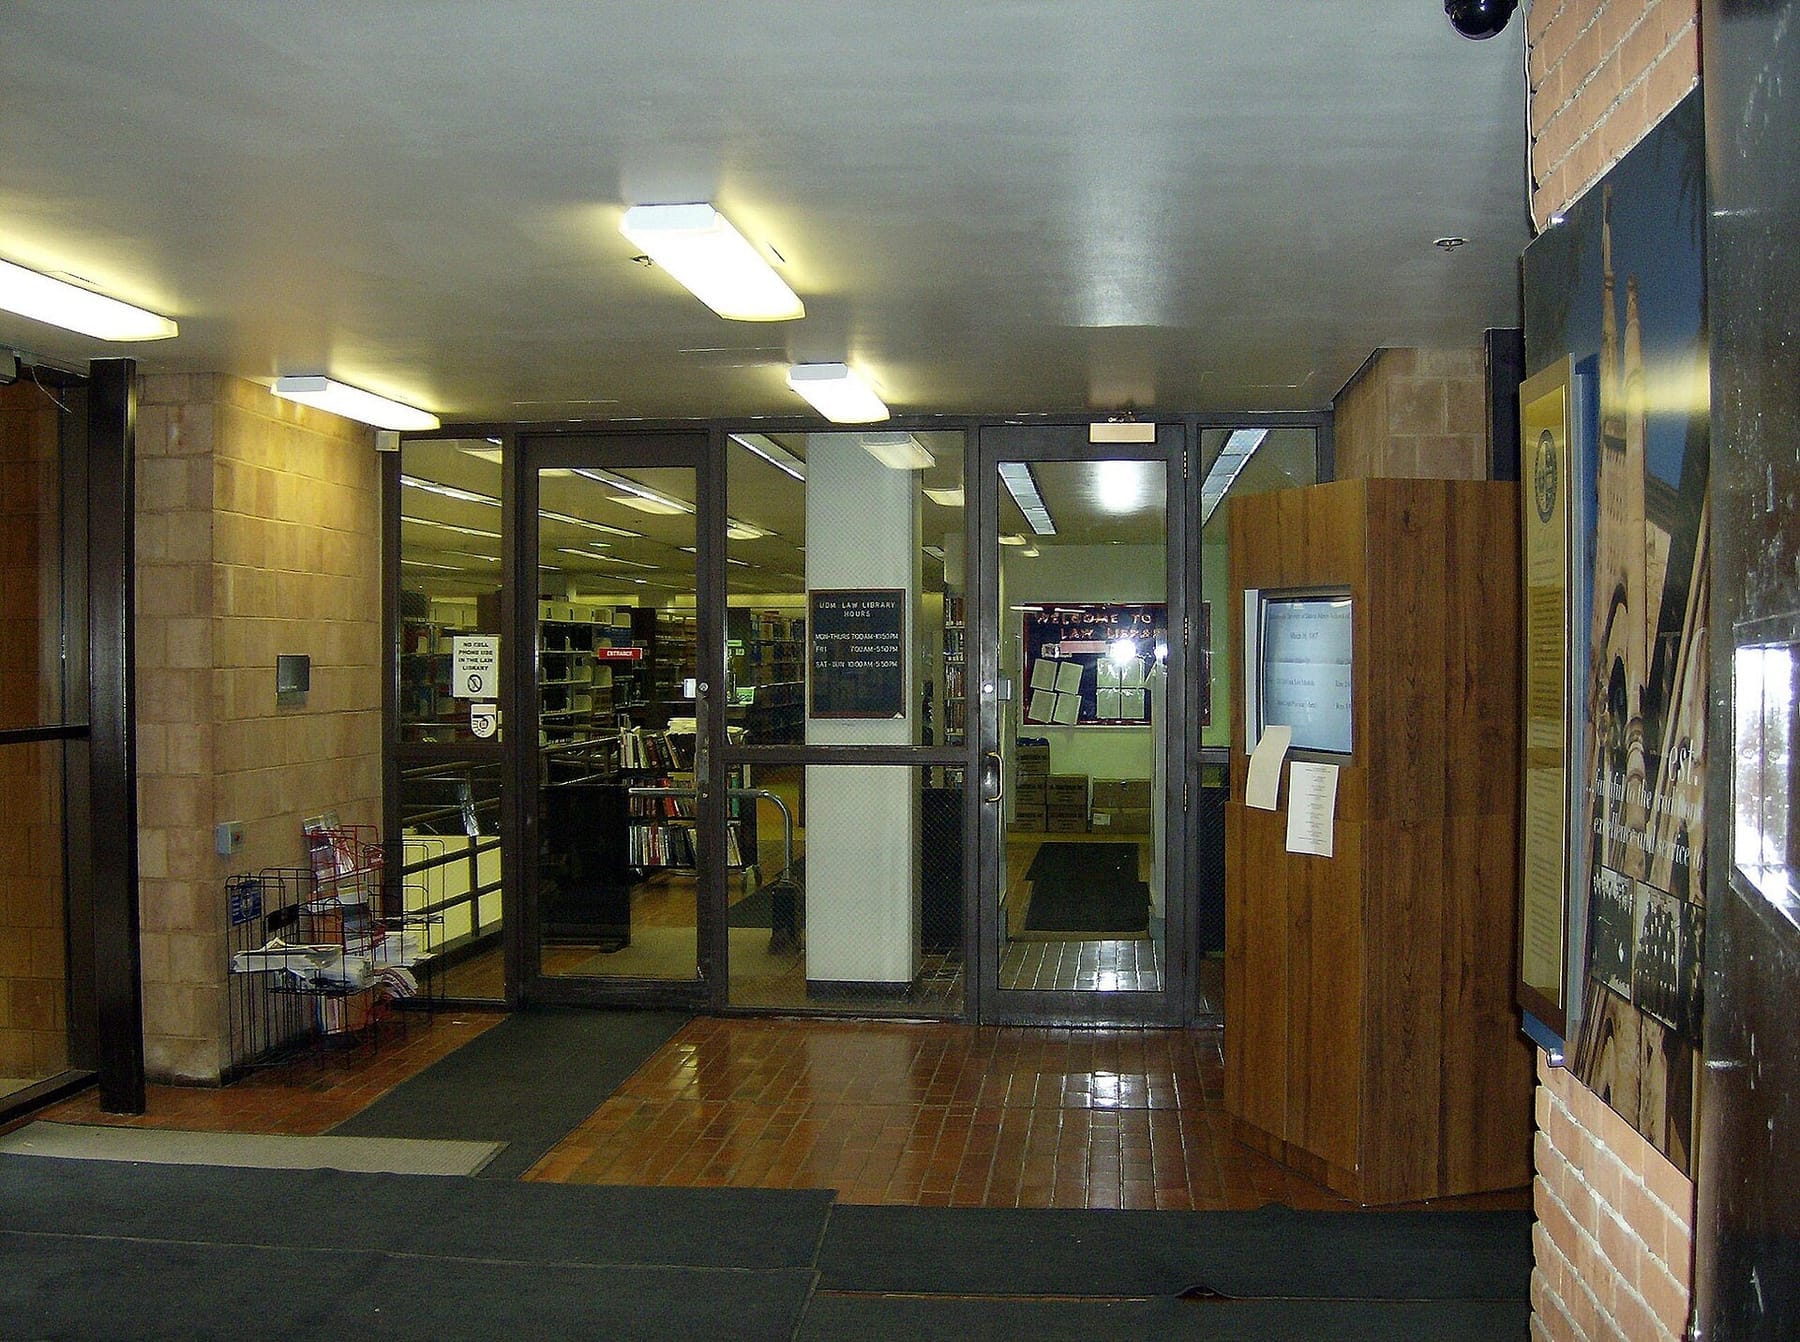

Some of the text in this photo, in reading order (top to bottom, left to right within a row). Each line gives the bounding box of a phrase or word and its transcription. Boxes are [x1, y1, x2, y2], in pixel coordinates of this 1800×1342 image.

[1037, 612, 1152, 625] WELCOME TO
[1060, 627, 1095, 640] LAW
[1668, 739, 1698, 786] est.
